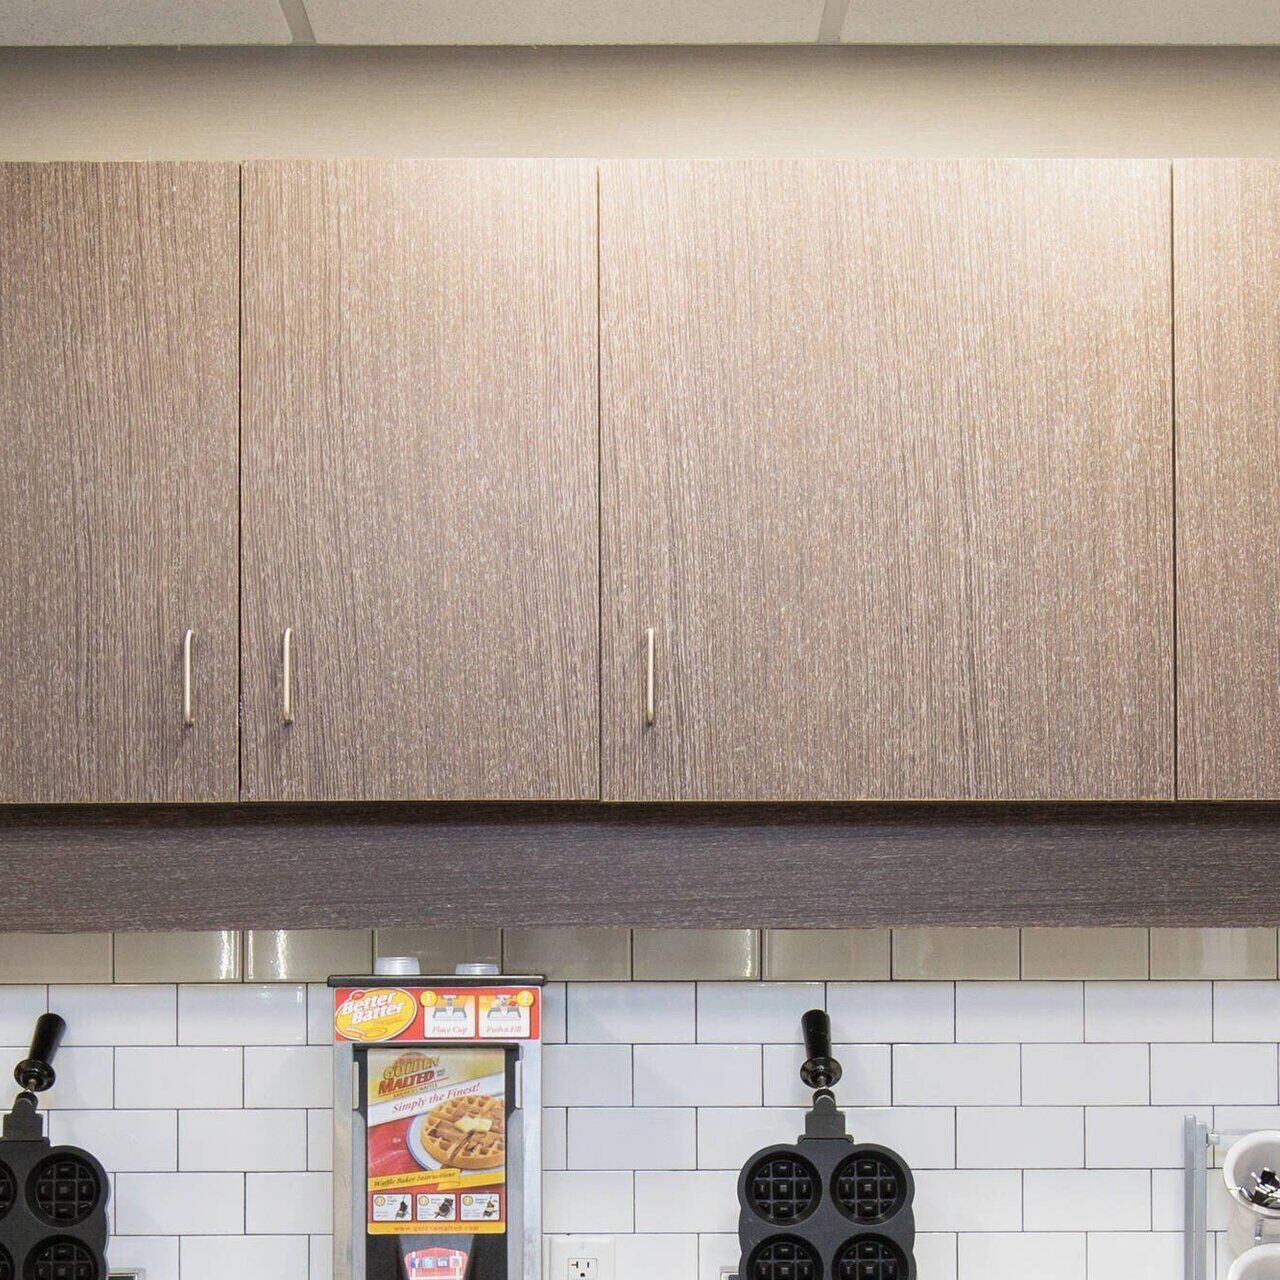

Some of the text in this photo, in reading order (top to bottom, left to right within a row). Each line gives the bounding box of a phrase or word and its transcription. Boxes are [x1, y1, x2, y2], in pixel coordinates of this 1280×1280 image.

[341, 991, 397, 1015] Better
[378, 1070, 435, 1095] MALTED
[393, 1098, 426, 1113] Simply
[429, 1093, 444, 1105] the
[447, 1083, 480, 1099] Finest!
[374, 1179, 396, 1187] Waffle
